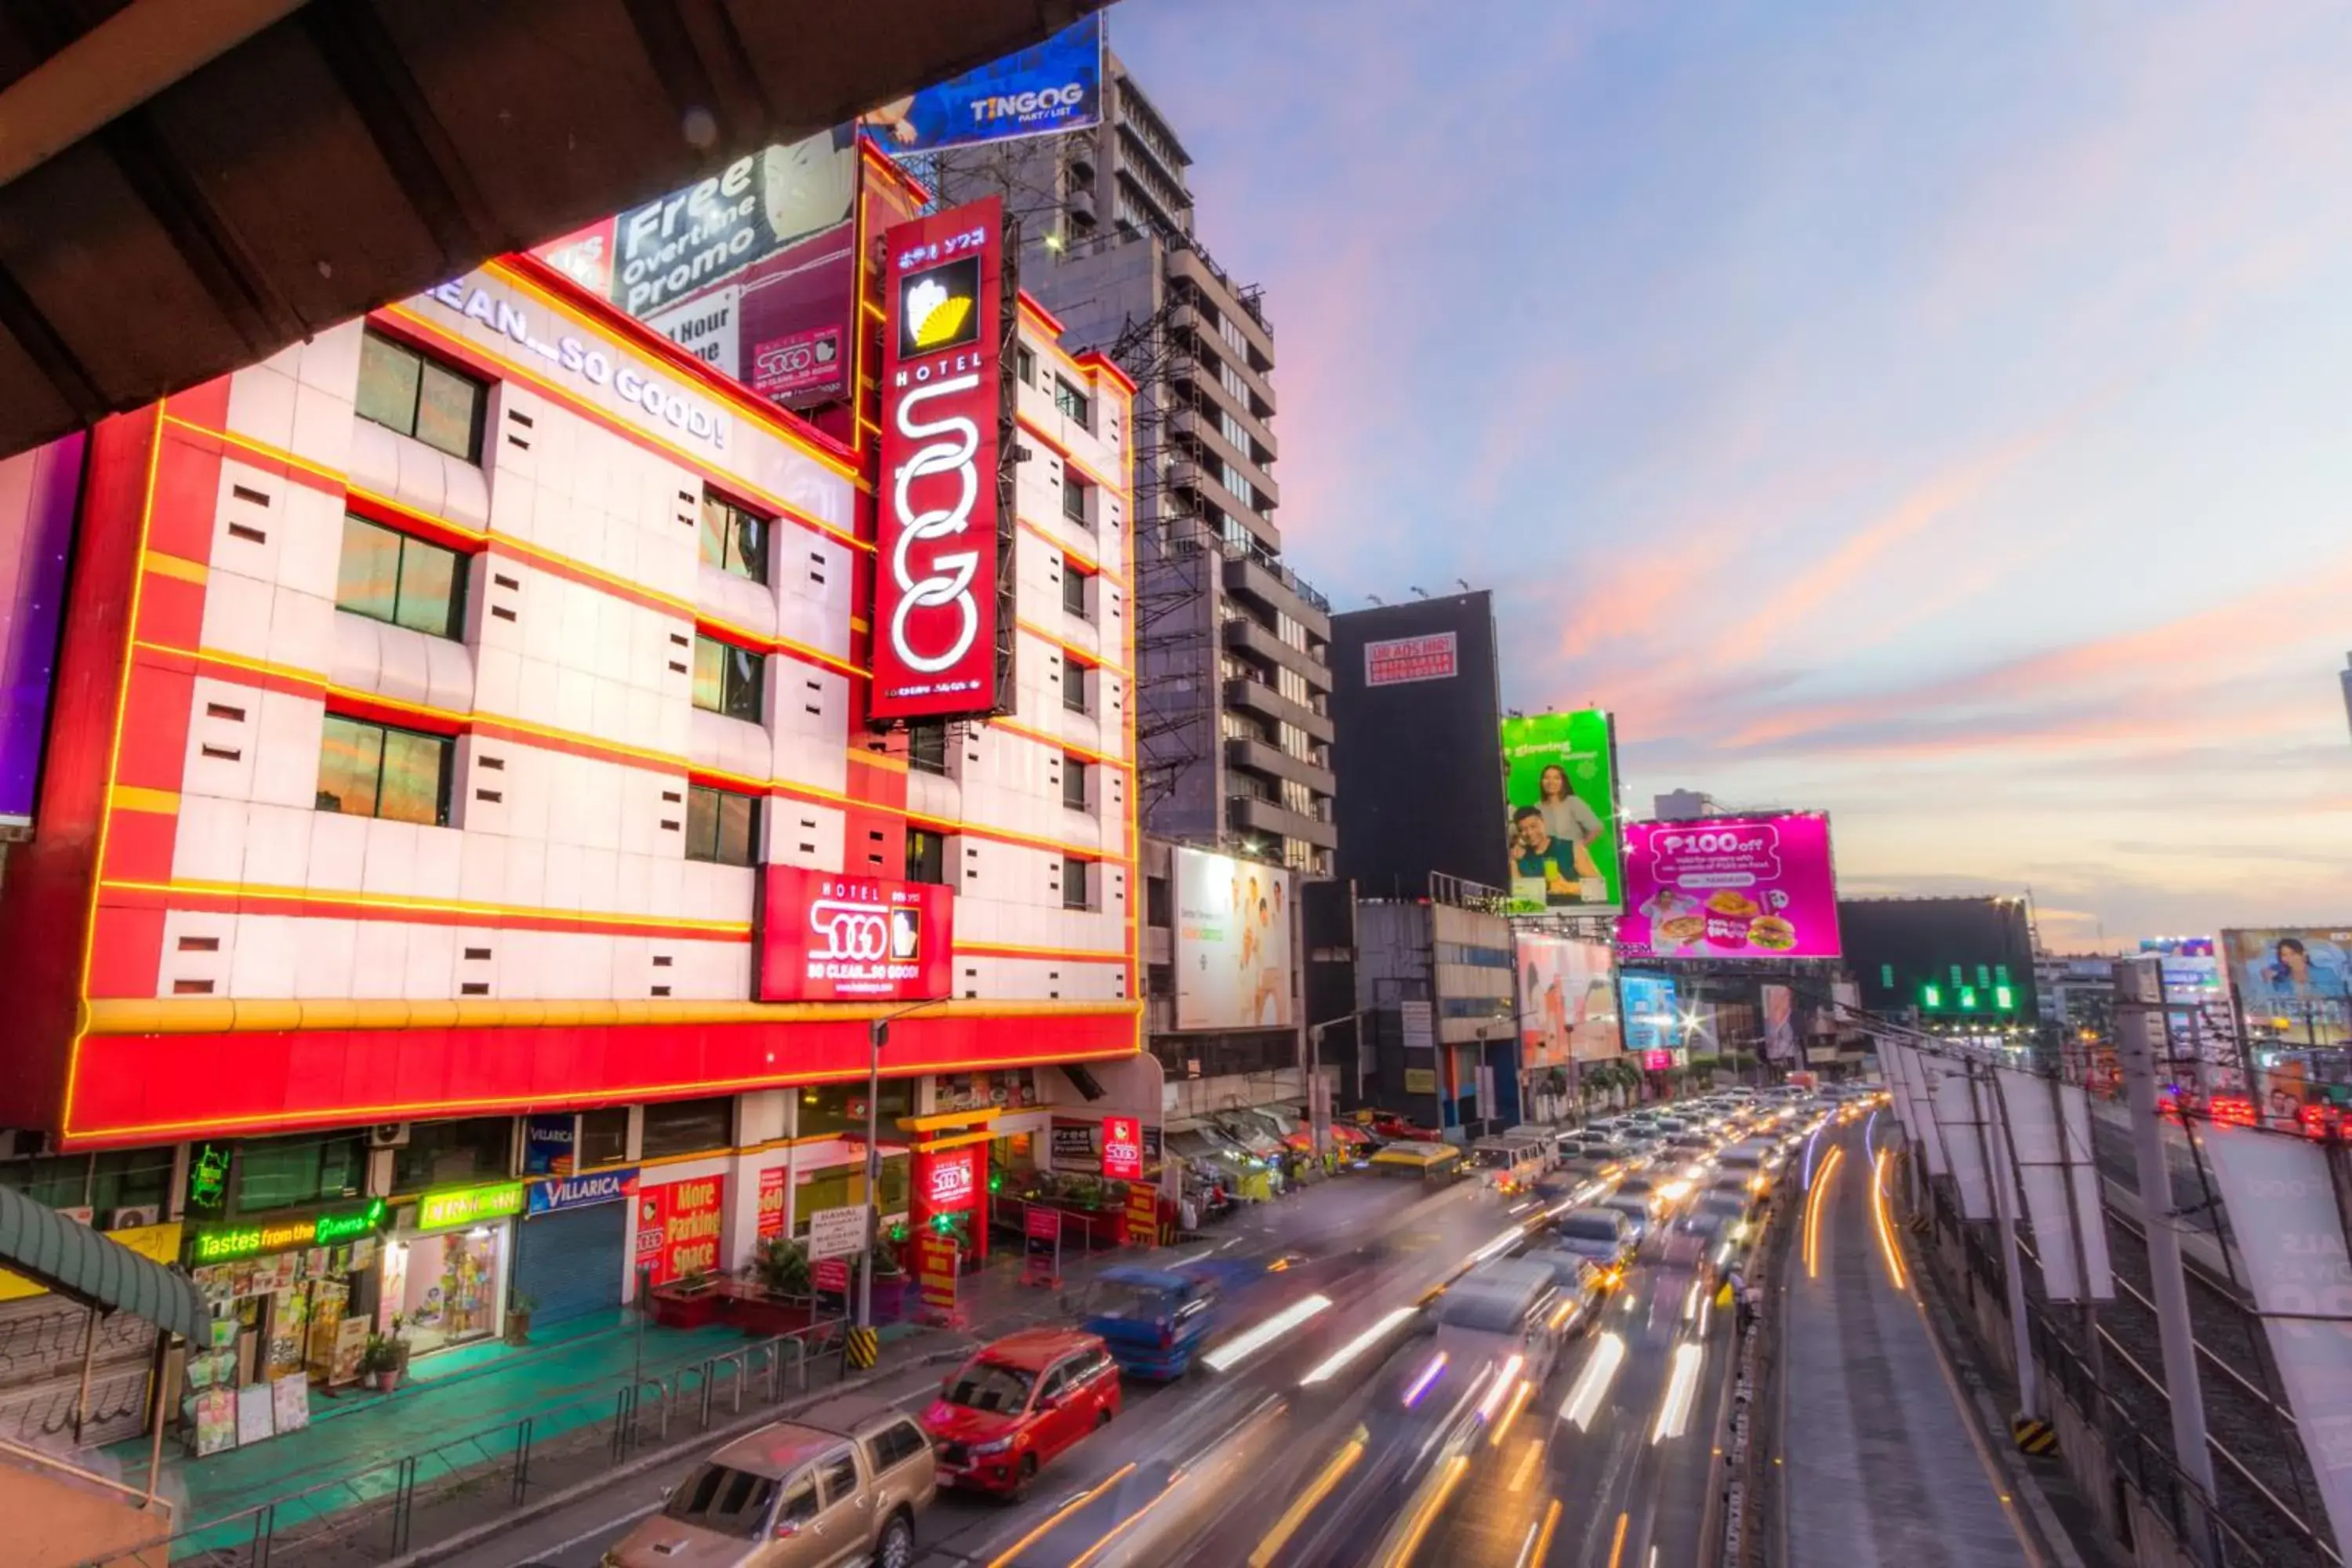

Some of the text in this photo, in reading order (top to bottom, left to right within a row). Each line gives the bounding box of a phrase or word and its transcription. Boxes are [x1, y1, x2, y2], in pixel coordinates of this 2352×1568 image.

[626, 155, 754, 261] Free
[627, 227, 756, 314] Promo
[896, 353, 982, 387] HOTEL
[613, 366, 724, 450] GOOD!
[891, 373, 979, 674] SOGO
[822, 883, 879, 901] HOTEL
[808, 899, 889, 960] SOGO
[531, 1127, 573, 1142] VILLARICA
[546, 1177, 619, 1207] VILLARICA
[677, 1183, 715, 1210] More
[201, 1230, 260, 1256] Tastes
[261, 1229, 292, 1246] from
[293, 1223, 315, 1240] the
[667, 1208, 720, 1245] Parking
[673, 1242, 715, 1276] Space
